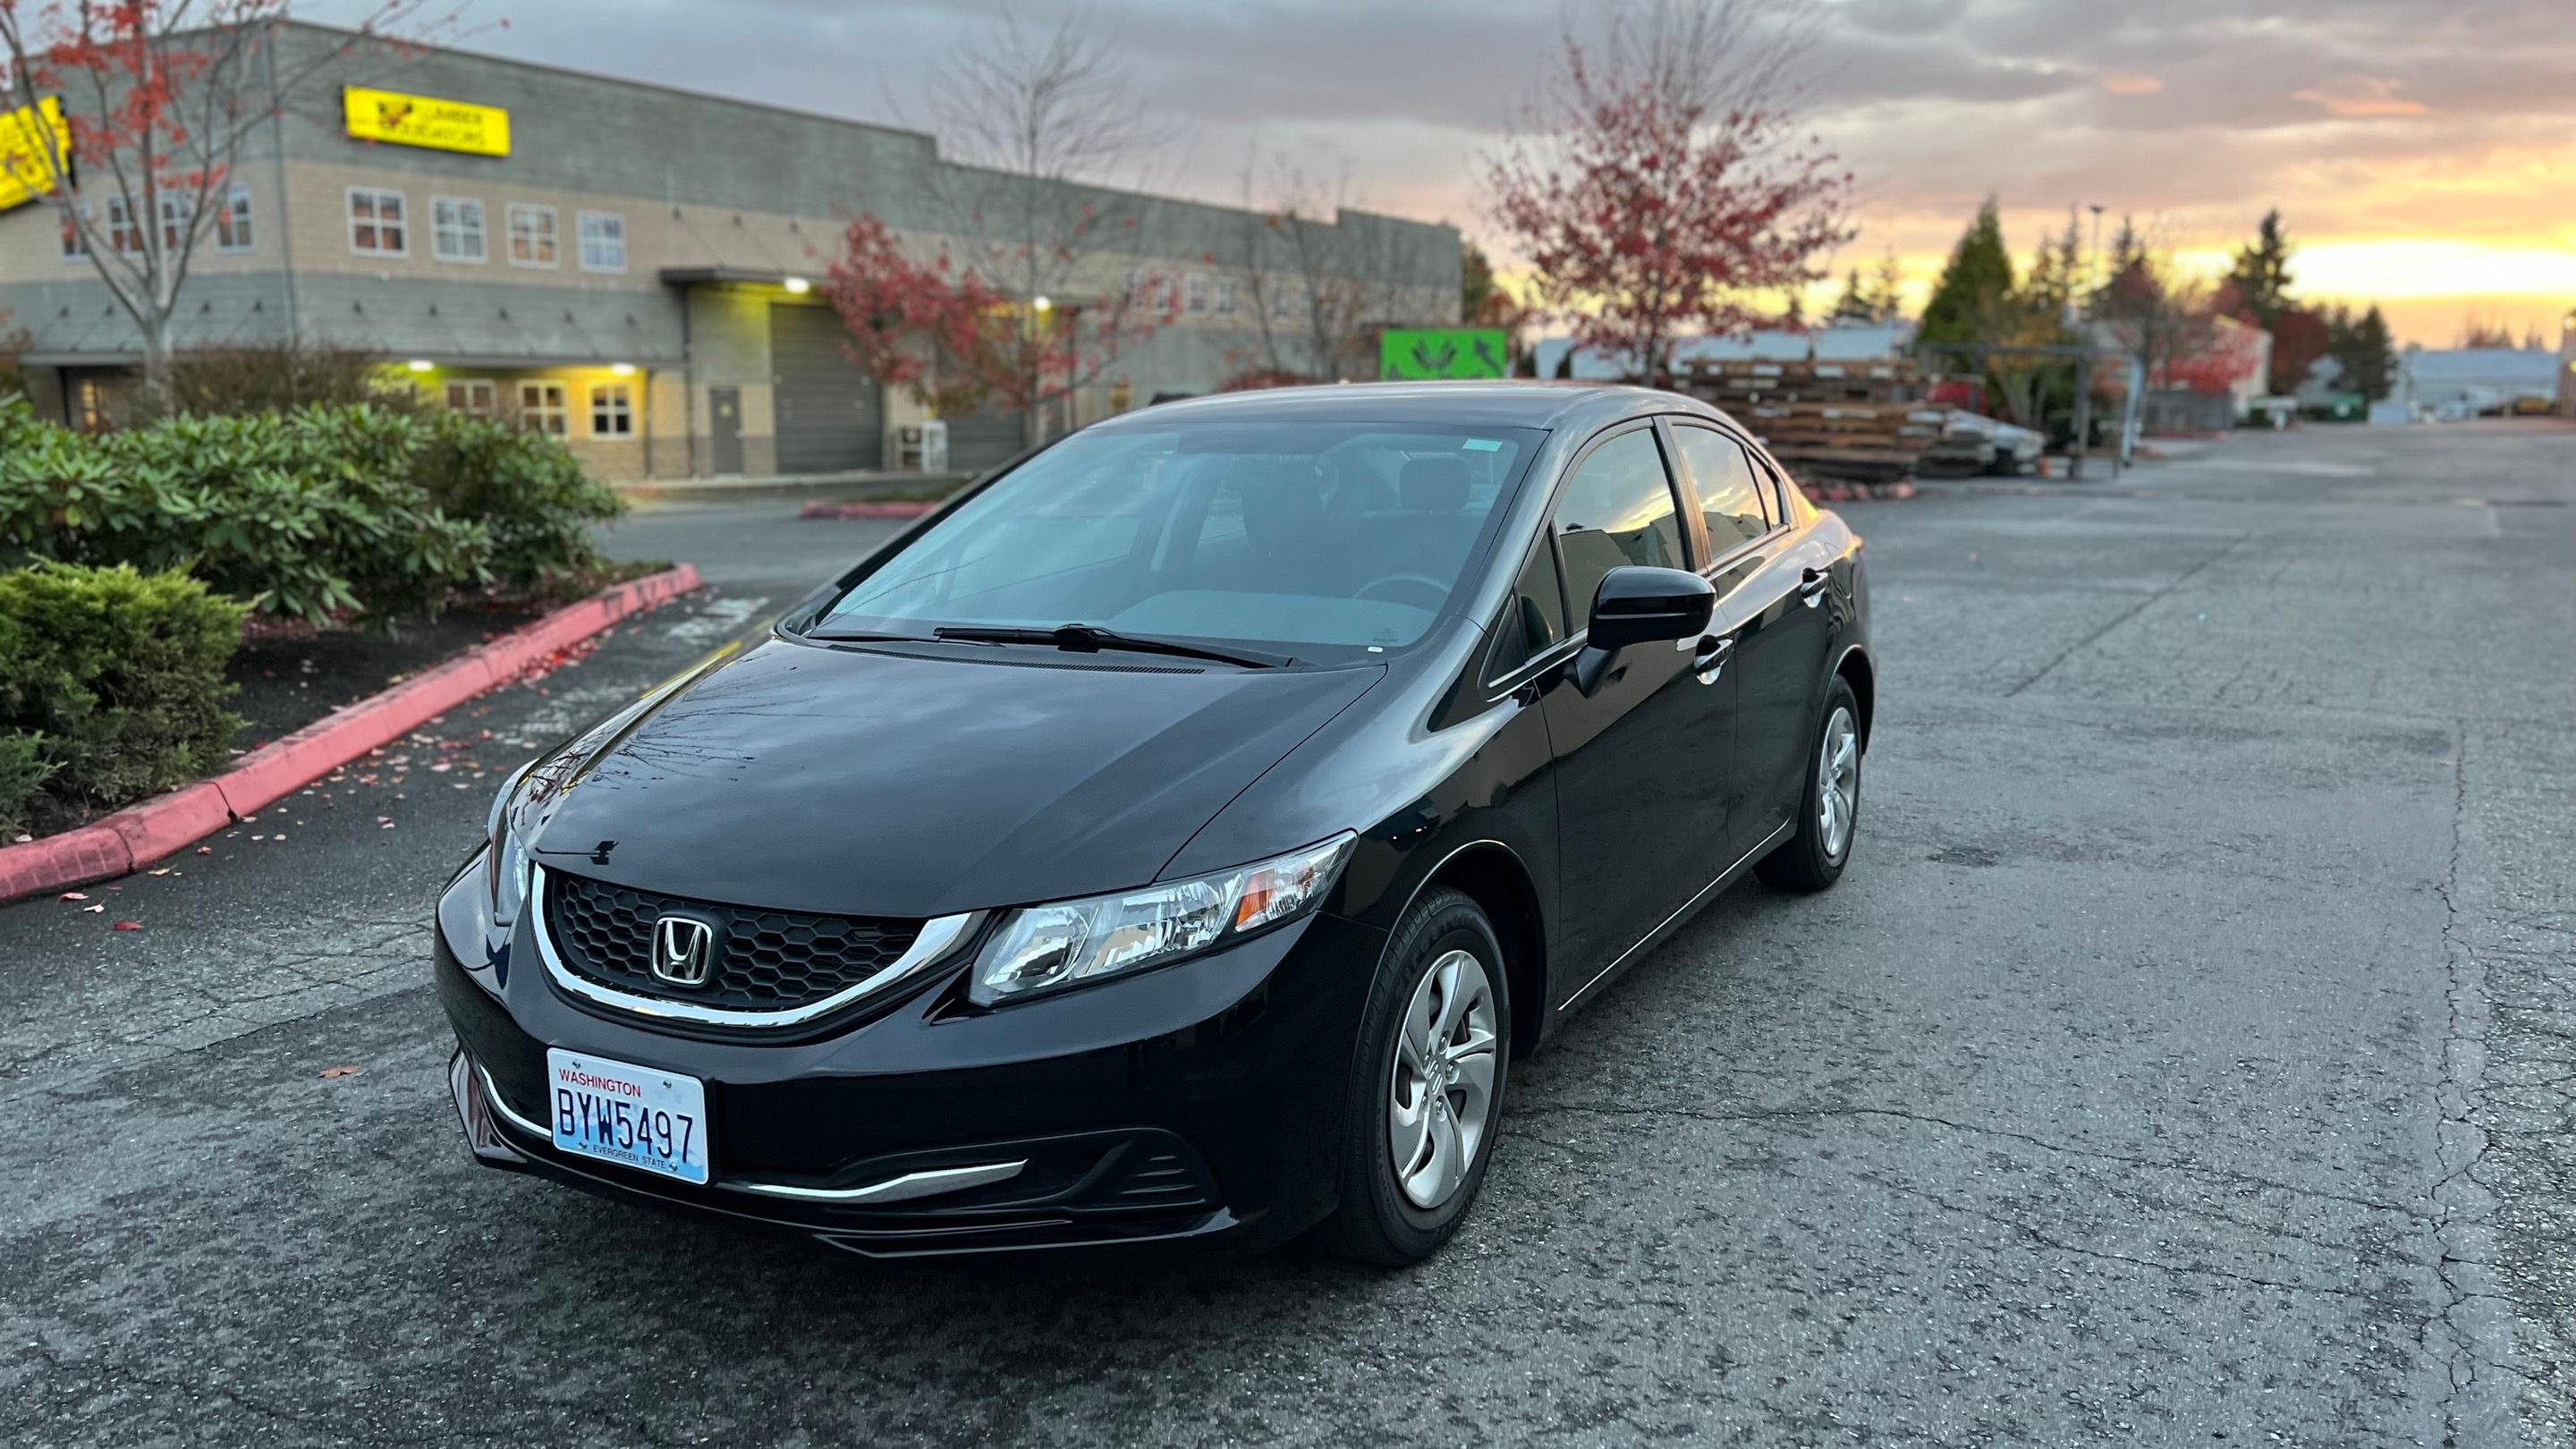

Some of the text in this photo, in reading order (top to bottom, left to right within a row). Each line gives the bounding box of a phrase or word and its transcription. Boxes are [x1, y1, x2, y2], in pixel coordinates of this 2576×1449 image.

[558, 1068, 641, 1097] WASHINGTON
[557, 1087, 693, 1164] BYW5497
[592, 1144, 666, 1169] EVERGREEN STATE
